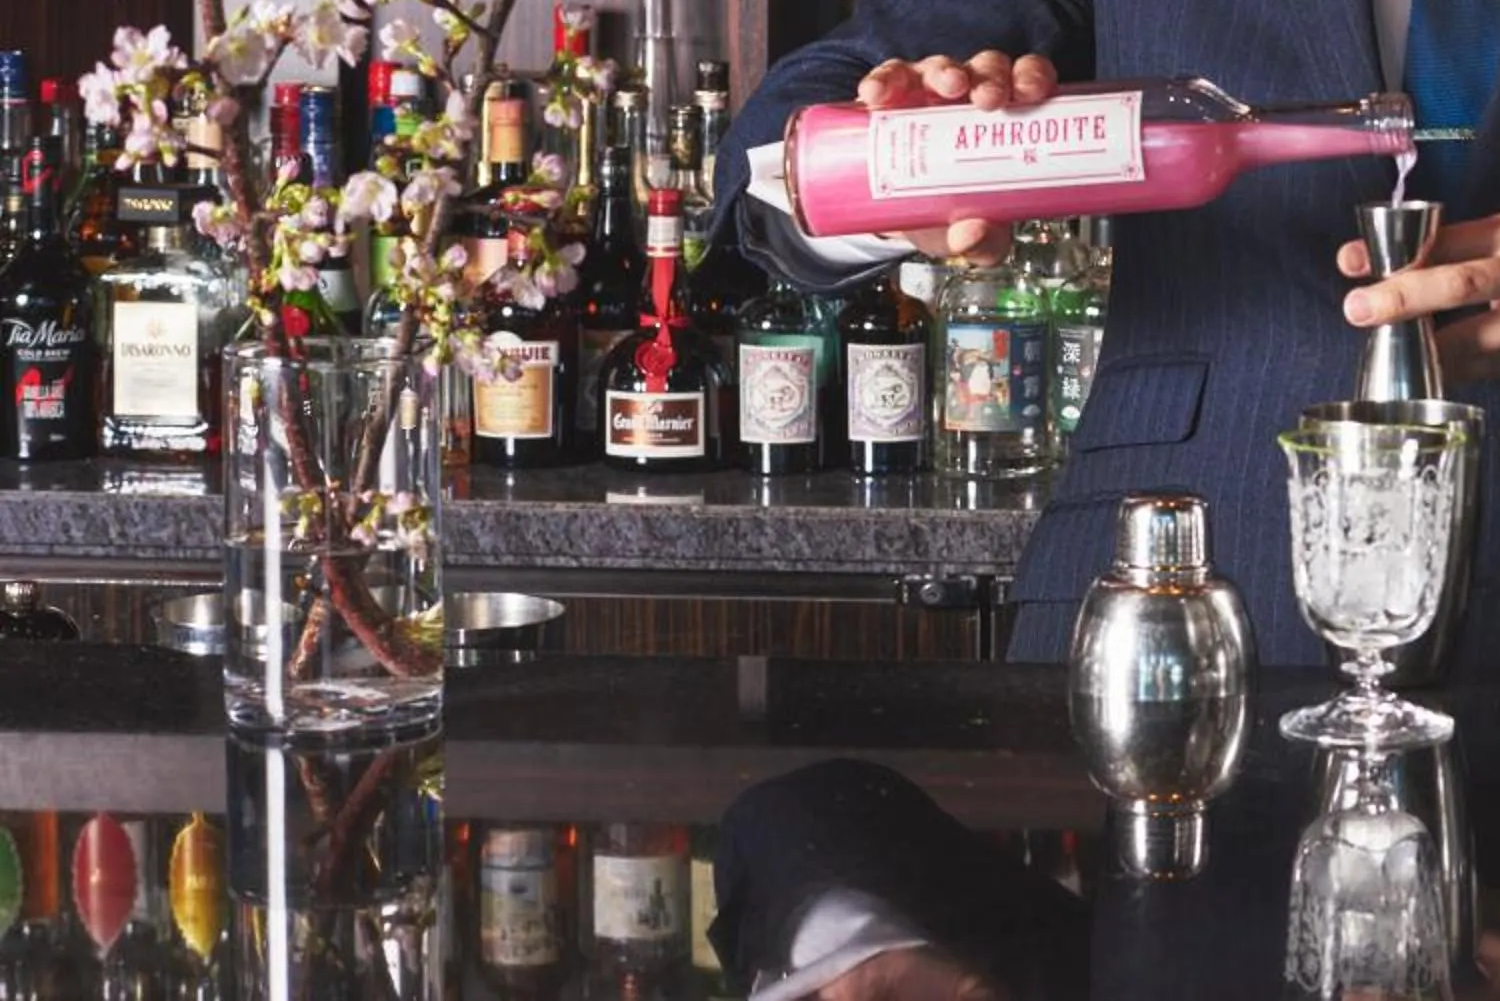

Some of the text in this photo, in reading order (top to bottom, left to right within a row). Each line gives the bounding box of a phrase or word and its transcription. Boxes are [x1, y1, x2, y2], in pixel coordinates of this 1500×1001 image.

[955, 115, 1106, 150] APHRODITE
[1, 317, 86, 347] Tia Maria
